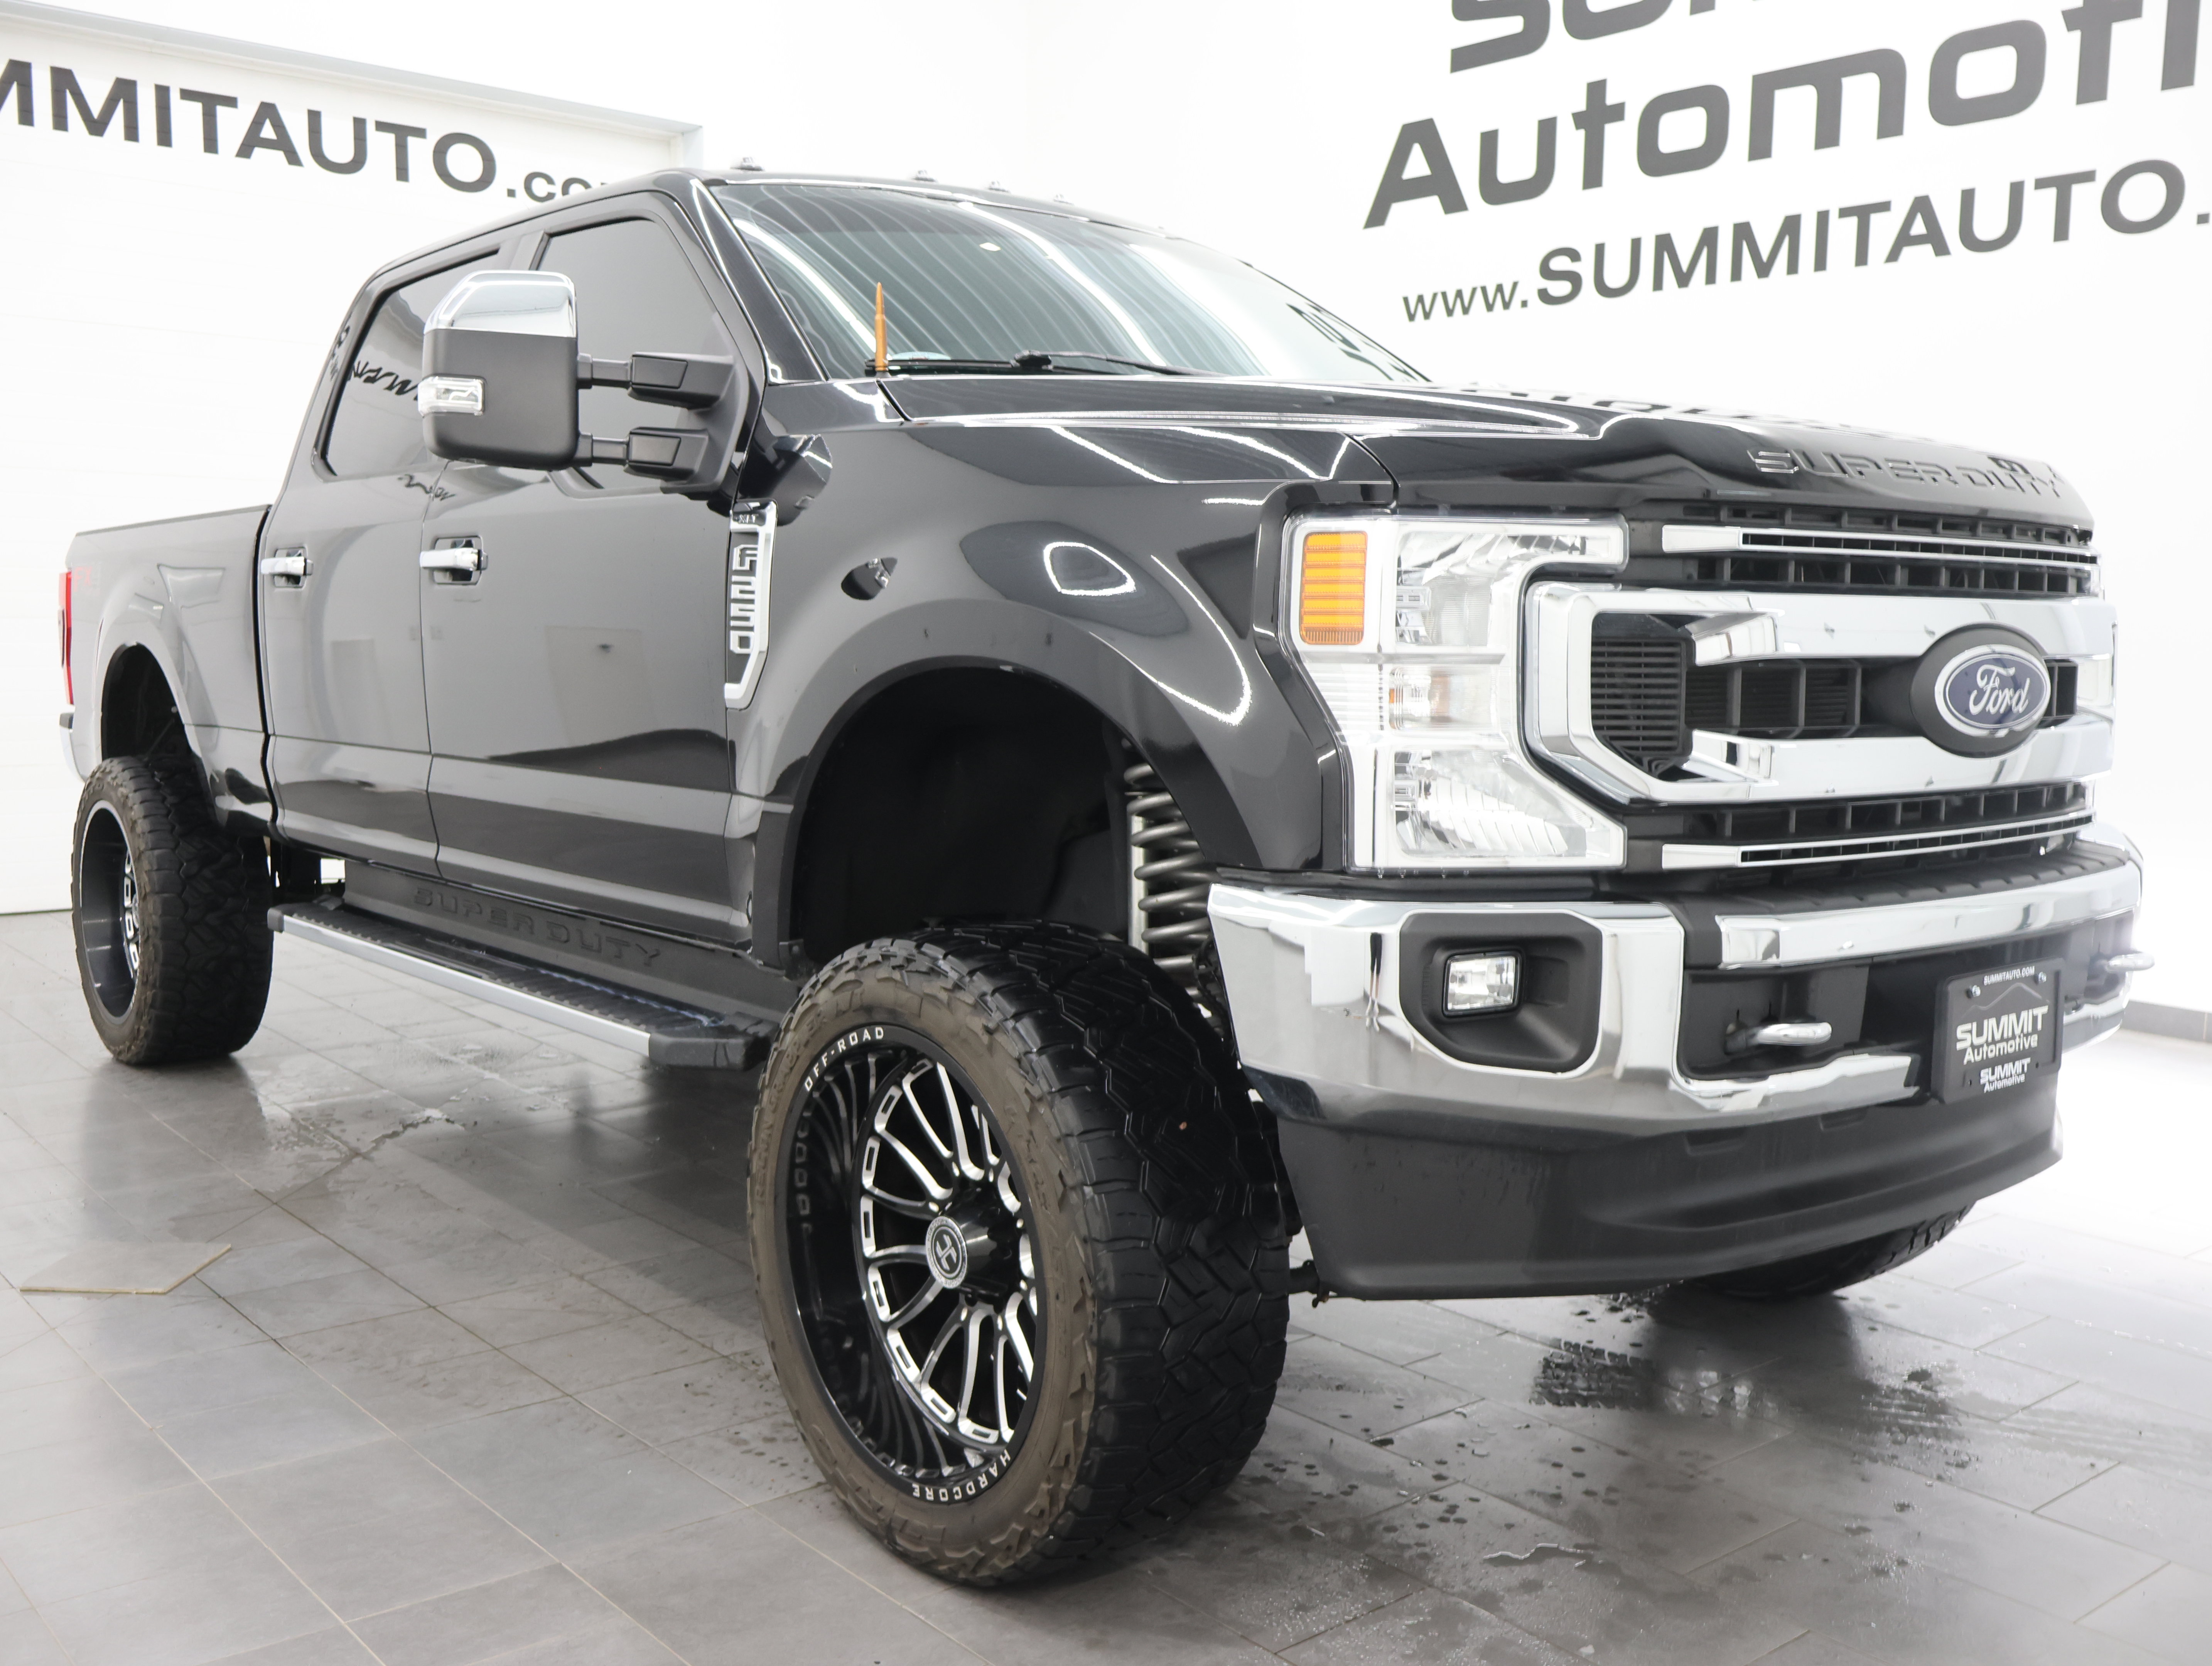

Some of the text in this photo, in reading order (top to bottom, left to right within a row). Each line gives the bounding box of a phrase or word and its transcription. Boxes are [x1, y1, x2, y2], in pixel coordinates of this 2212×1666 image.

[1747, 450, 1959, 487] SUPER
[1969, 664, 2030, 715] Ford
[413, 886, 661, 967] SUPER DUTY
[1983, 966, 2035, 986] SUMMITAUTO.COM
[1956, 1005, 2048, 1051] SUMMIT
[804, 1026, 885, 1092] OFF-ROAD
[1964, 1034, 2038, 1065] Automotive
[1980, 1057, 2031, 1084] SUMMIT
[1984, 1074, 2025, 1093] Automotive
[912, 1450, 1011, 1502] HARDCORE
